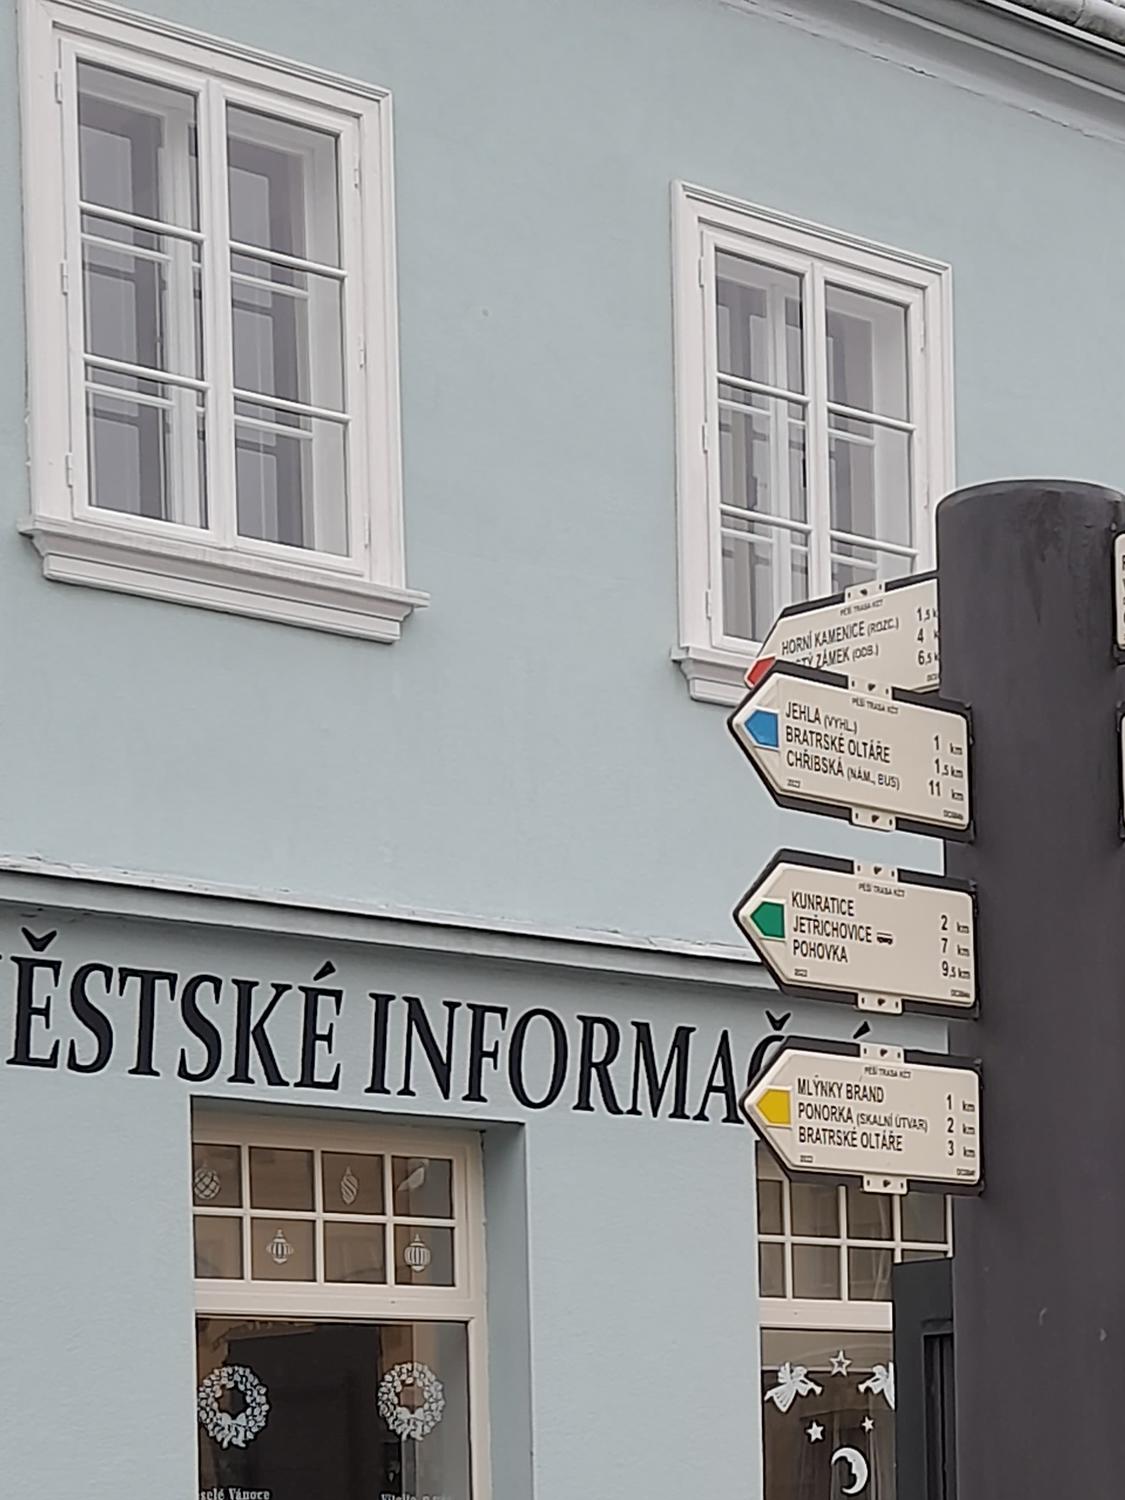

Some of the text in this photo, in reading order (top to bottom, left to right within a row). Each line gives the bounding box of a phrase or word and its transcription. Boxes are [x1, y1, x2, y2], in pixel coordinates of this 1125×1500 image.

[782, 629, 812, 655] HORNÍ
[814, 621, 865, 647] KAMENICE
[917, 607, 930, 622] 1,5
[816, 646, 850, 669] ZÁMEK
[917, 628, 924, 642] 4
[918, 650, 932, 666] 6,5
[786, 701, 821, 725] JEHLA
[934, 735, 939, 750] 1
[950, 743, 963, 755] km
[786, 725, 845, 754] BRATRSKÉ
[847, 739, 890, 763] OLTÁŘE
[951, 766, 963, 778] km
[786, 749, 844, 777] CHŘIBSKÁ
[877, 773, 900, 791] BUS)
[929, 780, 941, 797] 11
[952, 789, 964, 801] km
[791, 891, 970, 934] KUNRATICE 2 km
[793, 914, 970, 957] JETŘICHOVICE 7 km
[793, 938, 970, 980] POHOVKA 9,5 km
[0, 927, 344, 1091] ĚSTSKÉ
[797, 1074, 975, 1112] MLÝNKY BRAND 1 km
[798, 1102, 854, 1124] PONORKA
[856, 1112, 893, 1128] (SKALNÍ
[947, 1117, 954, 1133] 2
[962, 1123, 975, 1135] km
[798, 1125, 975, 1158] BRATRSKÉ OLTÁŘE 3 km
[228, 1487, 271, 1500] Vánoce
